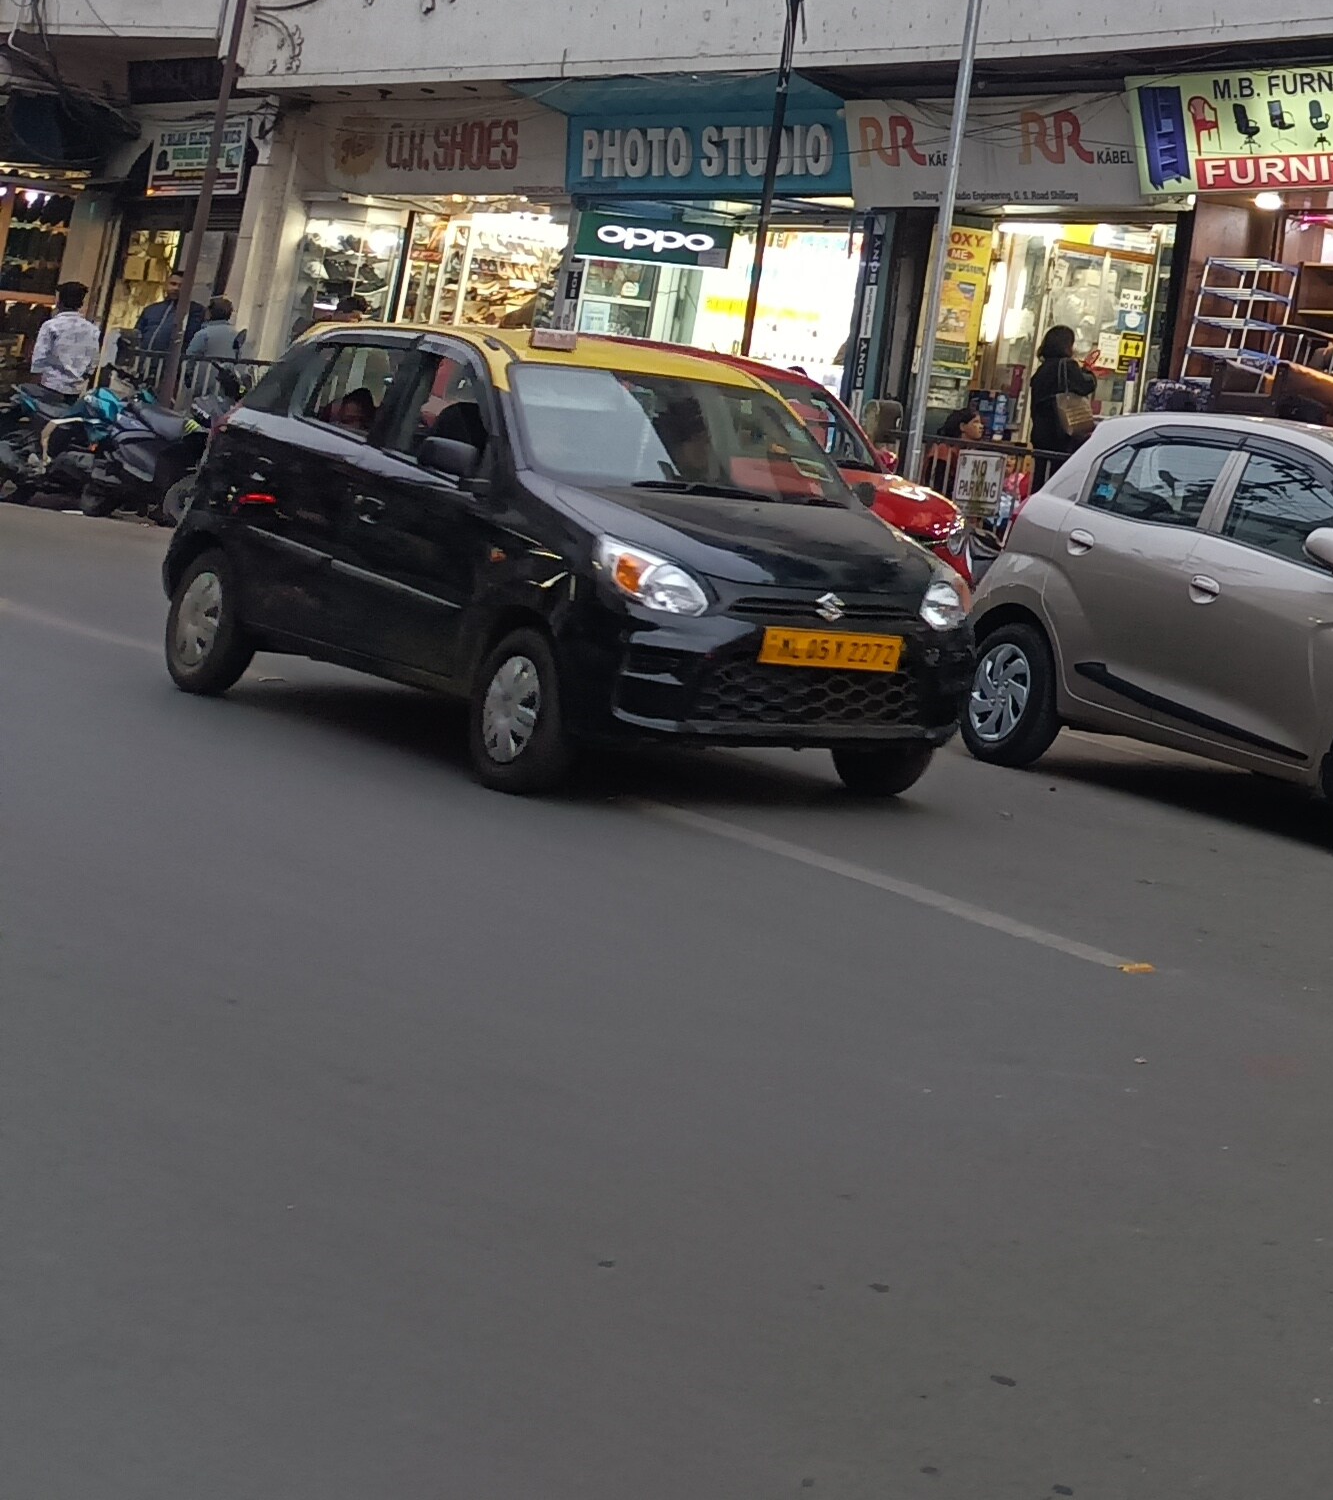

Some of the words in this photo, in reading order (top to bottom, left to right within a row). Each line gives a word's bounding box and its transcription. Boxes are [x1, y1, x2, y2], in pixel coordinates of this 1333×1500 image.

[1212, 77, 1261, 100] M.B.
[433, 119, 519, 171] SHOES
[581, 127, 692, 178] PHOTO
[858, 115, 927, 167] RR
[1018, 111, 1094, 165] RR
[597, 224, 715, 253] oppo
[856, 341, 866, 388] SONY
[971, 460, 988, 477] NO
